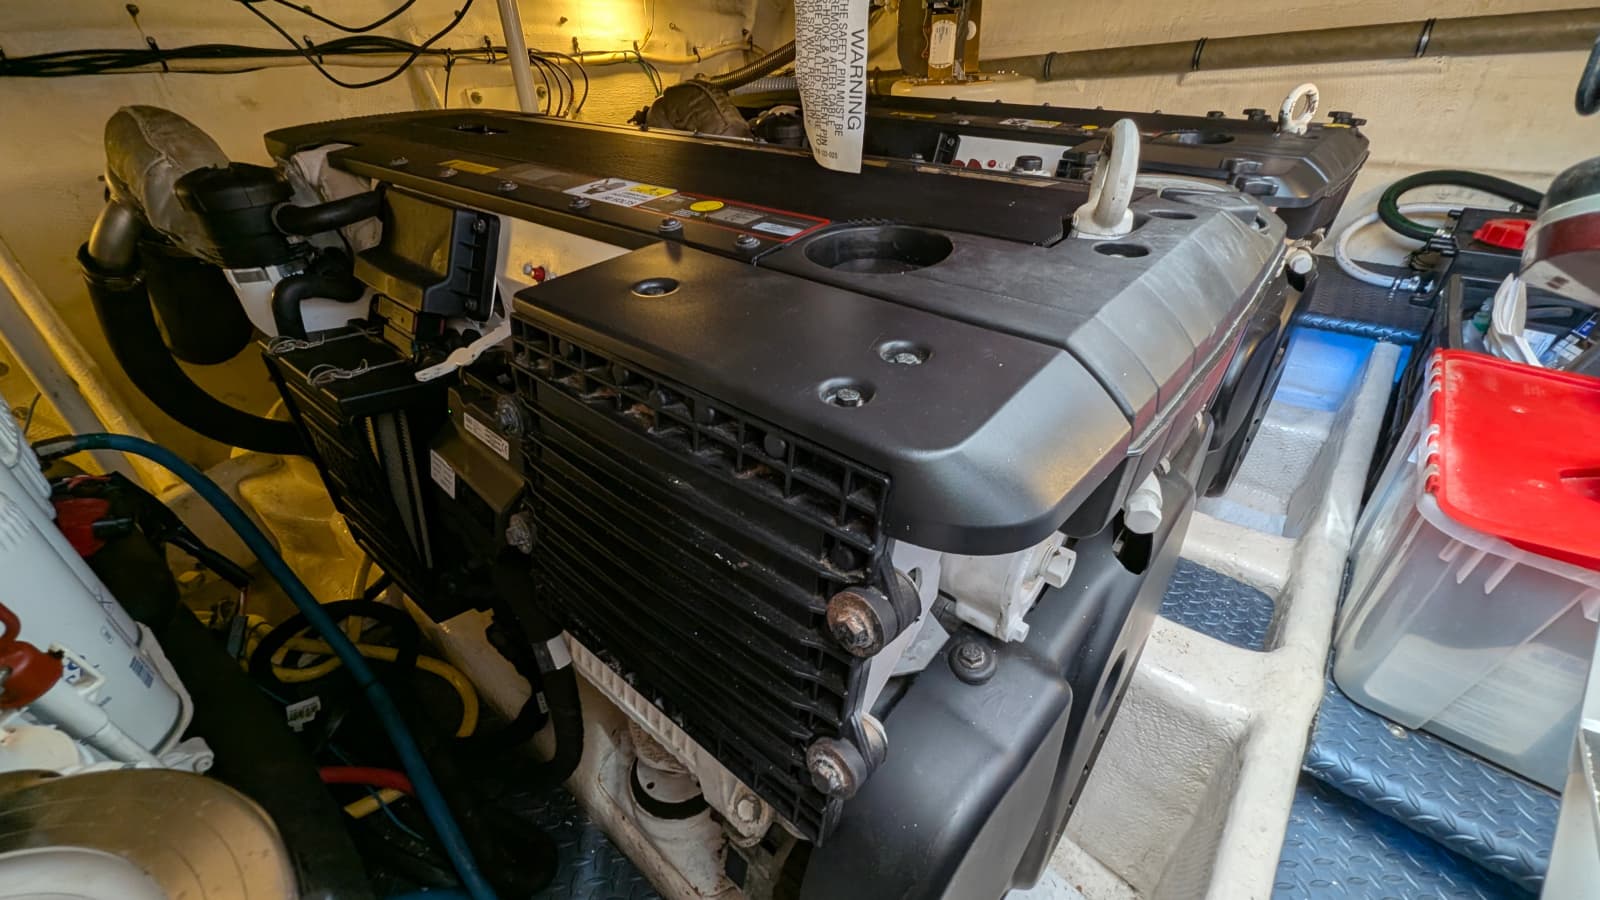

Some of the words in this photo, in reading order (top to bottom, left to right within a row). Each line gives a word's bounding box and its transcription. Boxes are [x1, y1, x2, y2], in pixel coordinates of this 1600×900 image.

[807, 17, 815, 33] SO
[822, 0, 831, 40] S-HOOK
[830, 0, 839, 53] REMOVED
[807, 35, 815, 62] WILL
[837, 22, 848, 64] SAFETY
[828, 56, 838, 90] AFTER
[837, 68, 846, 87] PIN
[847, 29, 864, 130] WARNING
[821, 57, 829, 125] ATTACHMENT
[836, 90, 846, 121] MUST
[827, 94, 836, 126] CABLE
[820, 128, 828, 146] PIN
[834, 123, 843, 137] BE
